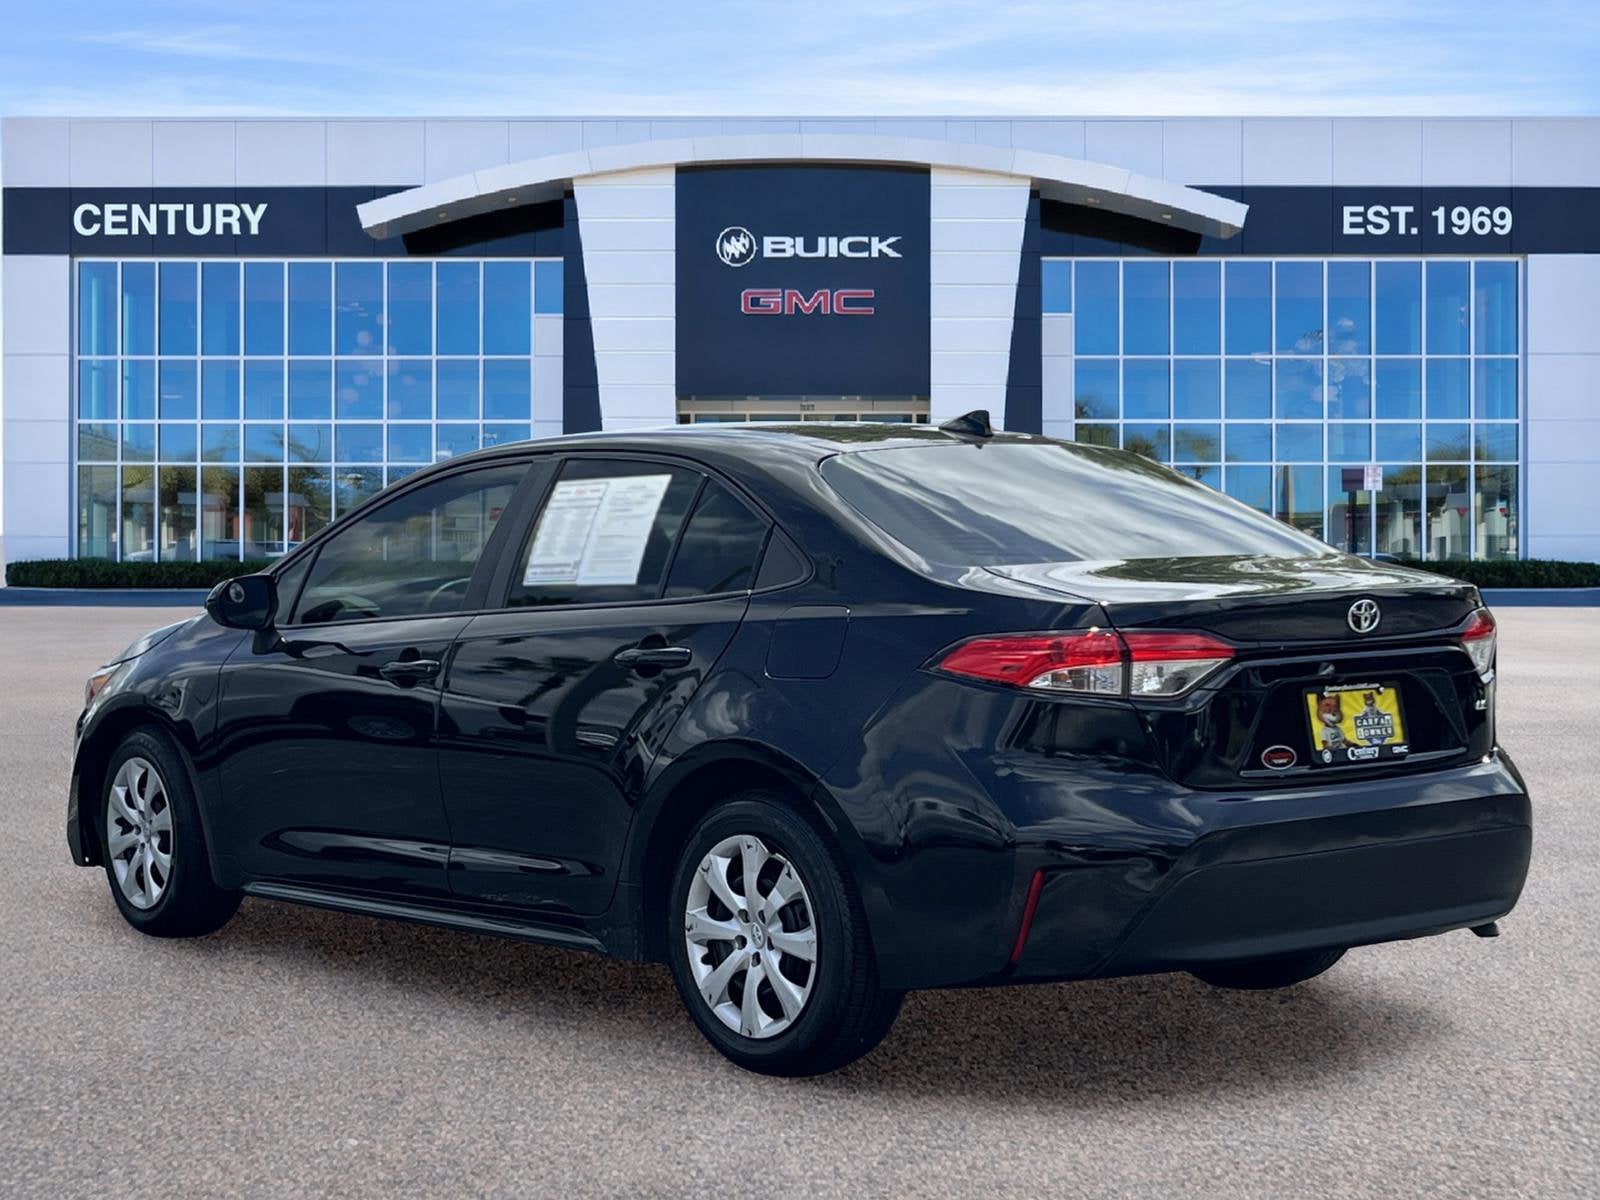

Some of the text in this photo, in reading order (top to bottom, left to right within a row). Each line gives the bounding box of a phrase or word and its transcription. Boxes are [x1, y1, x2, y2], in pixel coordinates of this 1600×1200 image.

[73, 203, 268, 236] CENTURY
[1342, 205, 1513, 235] EST. 1969
[763, 236, 903, 258] BUICK
[741, 289, 874, 315] GMC
